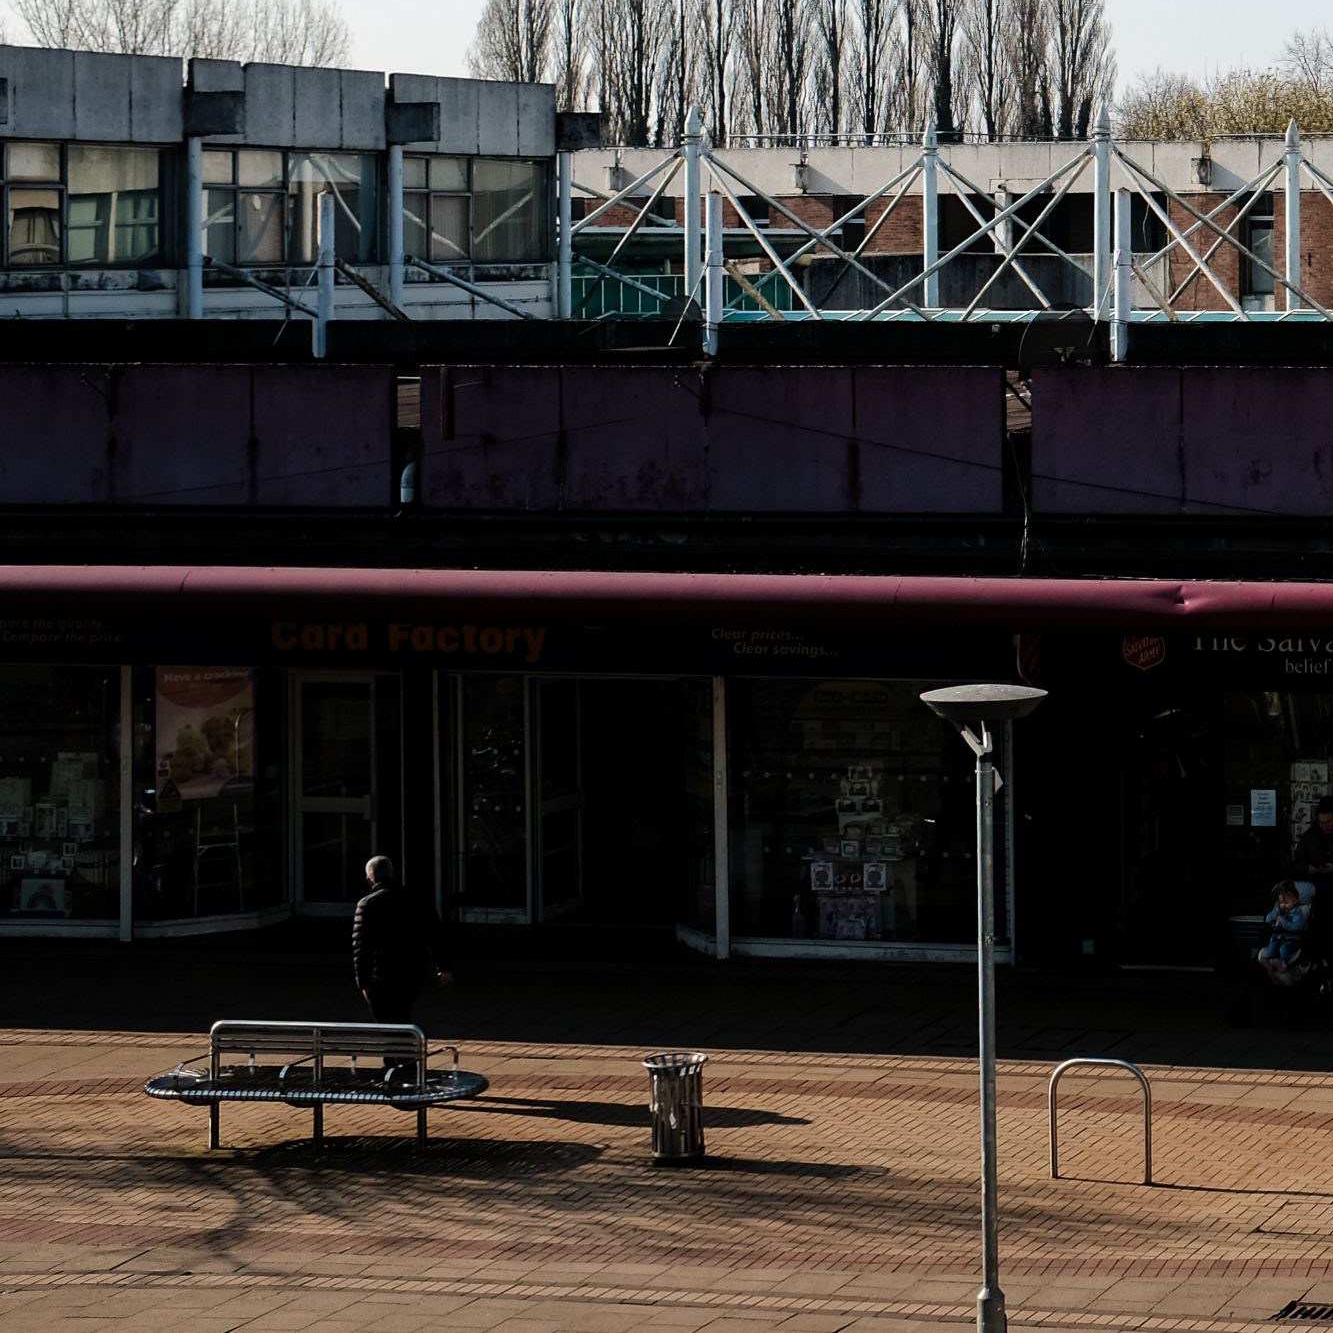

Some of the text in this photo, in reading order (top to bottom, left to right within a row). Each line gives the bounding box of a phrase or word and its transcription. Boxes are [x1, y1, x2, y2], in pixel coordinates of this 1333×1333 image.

[711, 627, 748, 640] Clear
[270, 619, 547, 664] Card Factory
[733, 641, 769, 655] Clear
[1285, 658, 1326, 674] belief
